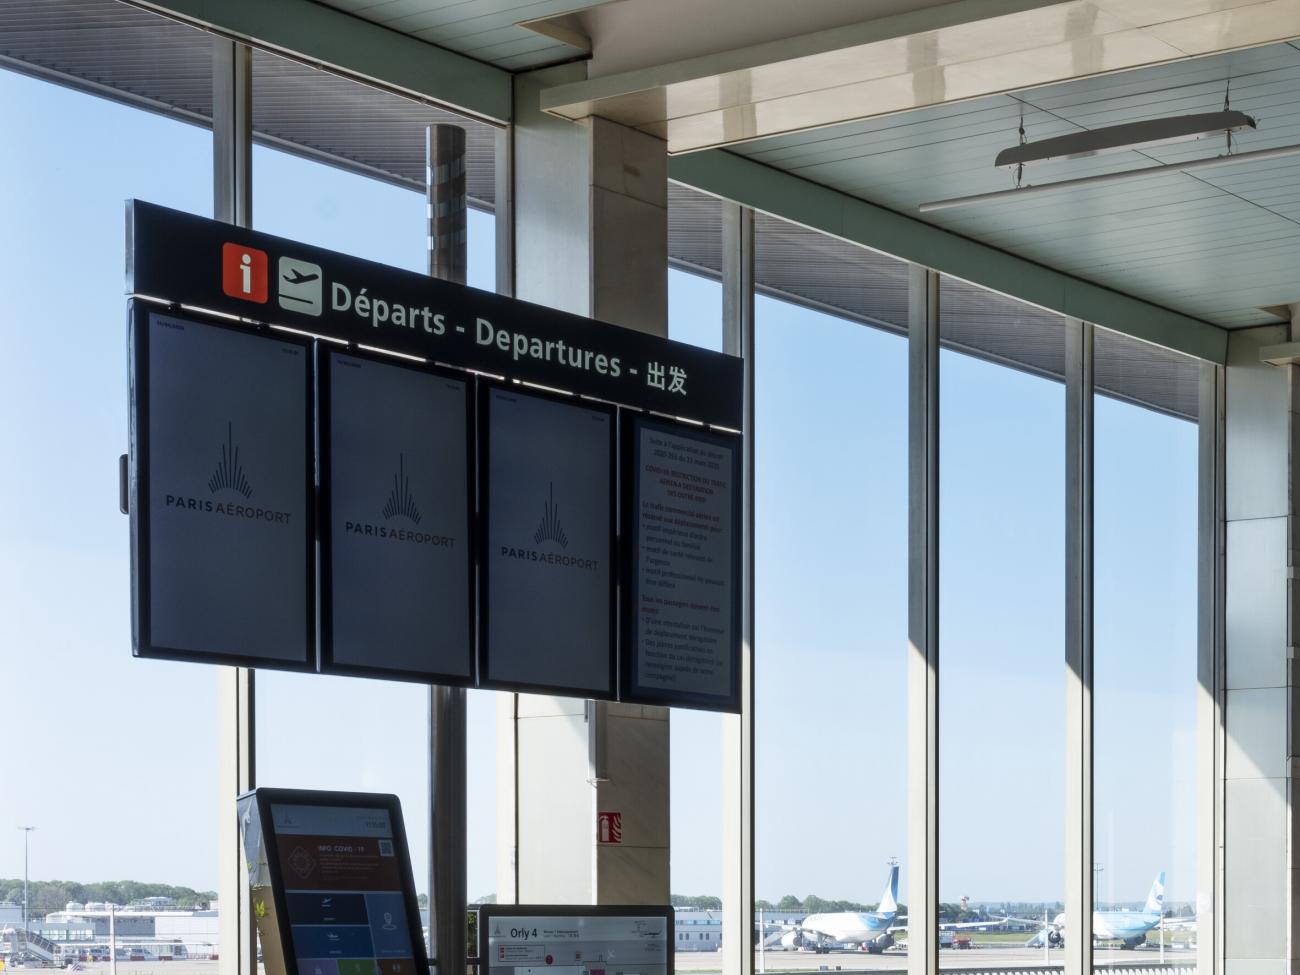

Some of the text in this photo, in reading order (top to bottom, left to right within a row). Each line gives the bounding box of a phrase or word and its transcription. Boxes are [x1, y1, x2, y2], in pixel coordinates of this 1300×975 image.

[332, 282, 445, 336] Départs
[476, 318, 620, 377] Departures
[647, 362, 687, 395] 出发
[511, 928, 529, 940] Orly
[532, 928, 538, 938] 4
